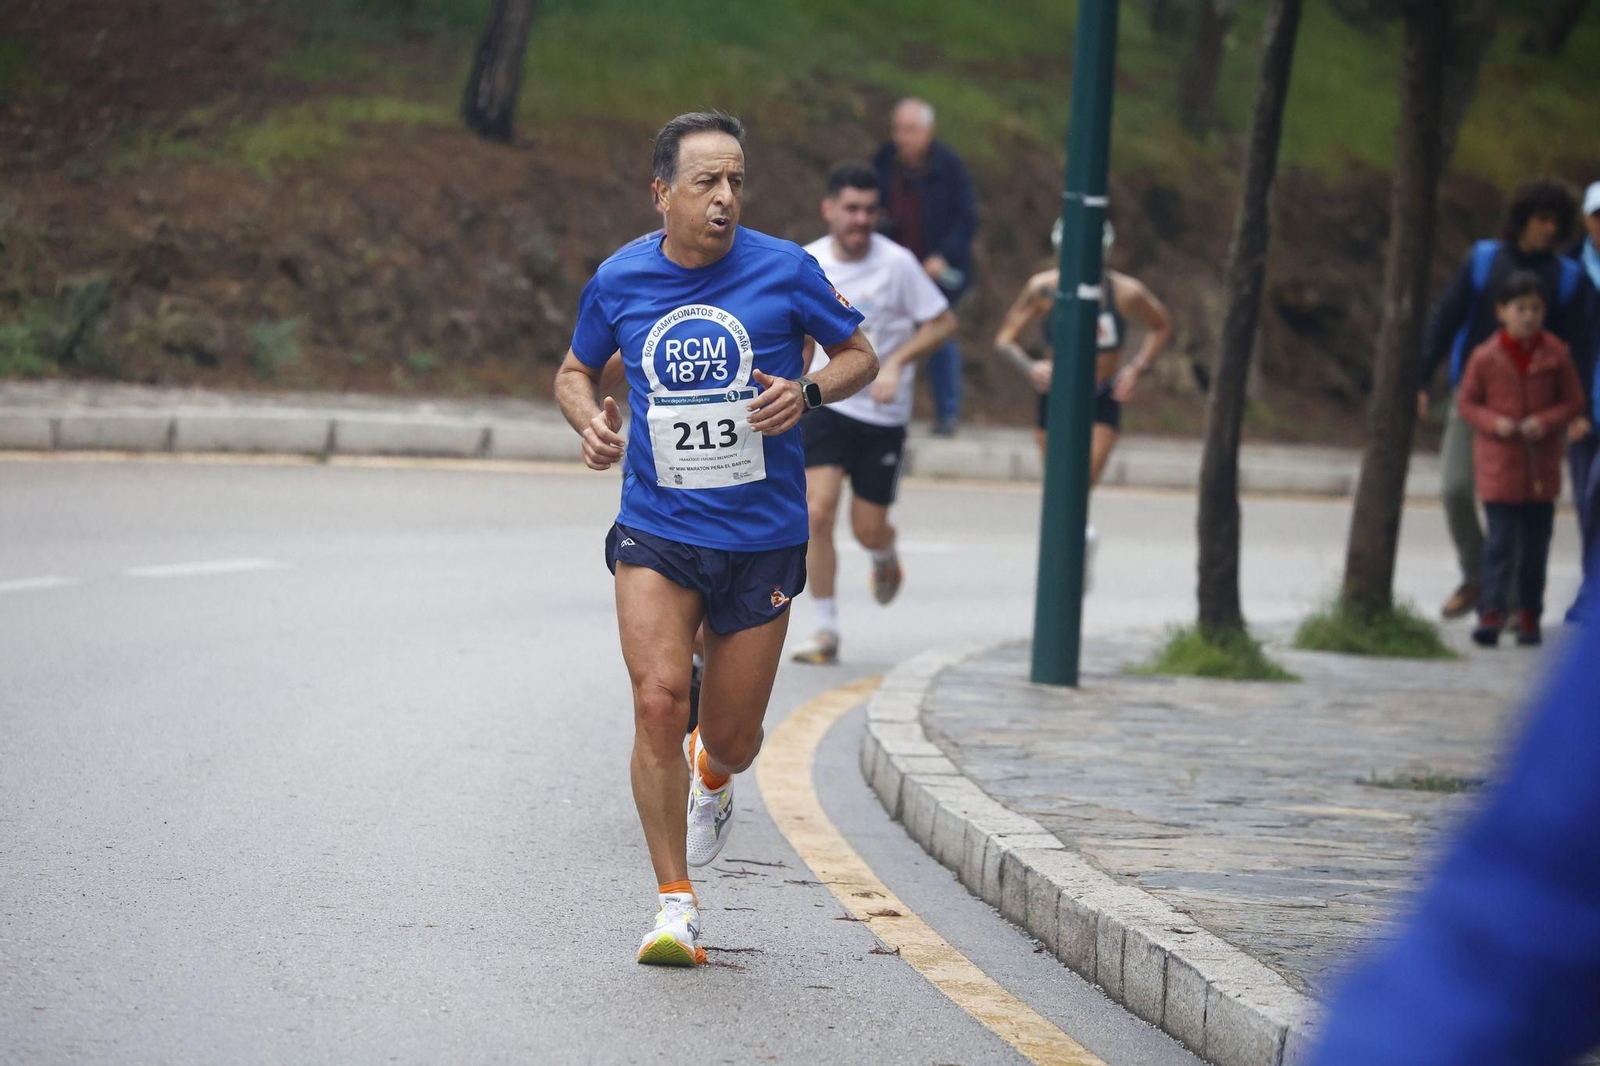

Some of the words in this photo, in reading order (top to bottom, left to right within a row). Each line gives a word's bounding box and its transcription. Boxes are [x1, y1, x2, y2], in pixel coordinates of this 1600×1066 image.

[645, 340, 655, 357] 500
[653, 308, 713, 337] CAMPEONATOS
[716, 312, 728, 323] DE
[728, 320, 749, 353] ESPAÑA
[665, 336, 727, 361] RCM
[665, 360, 728, 383] 1873
[673, 418, 738, 450] 213
[717, 452, 738, 461] BELMONTE
[731, 459, 752, 467] BASTÓN
